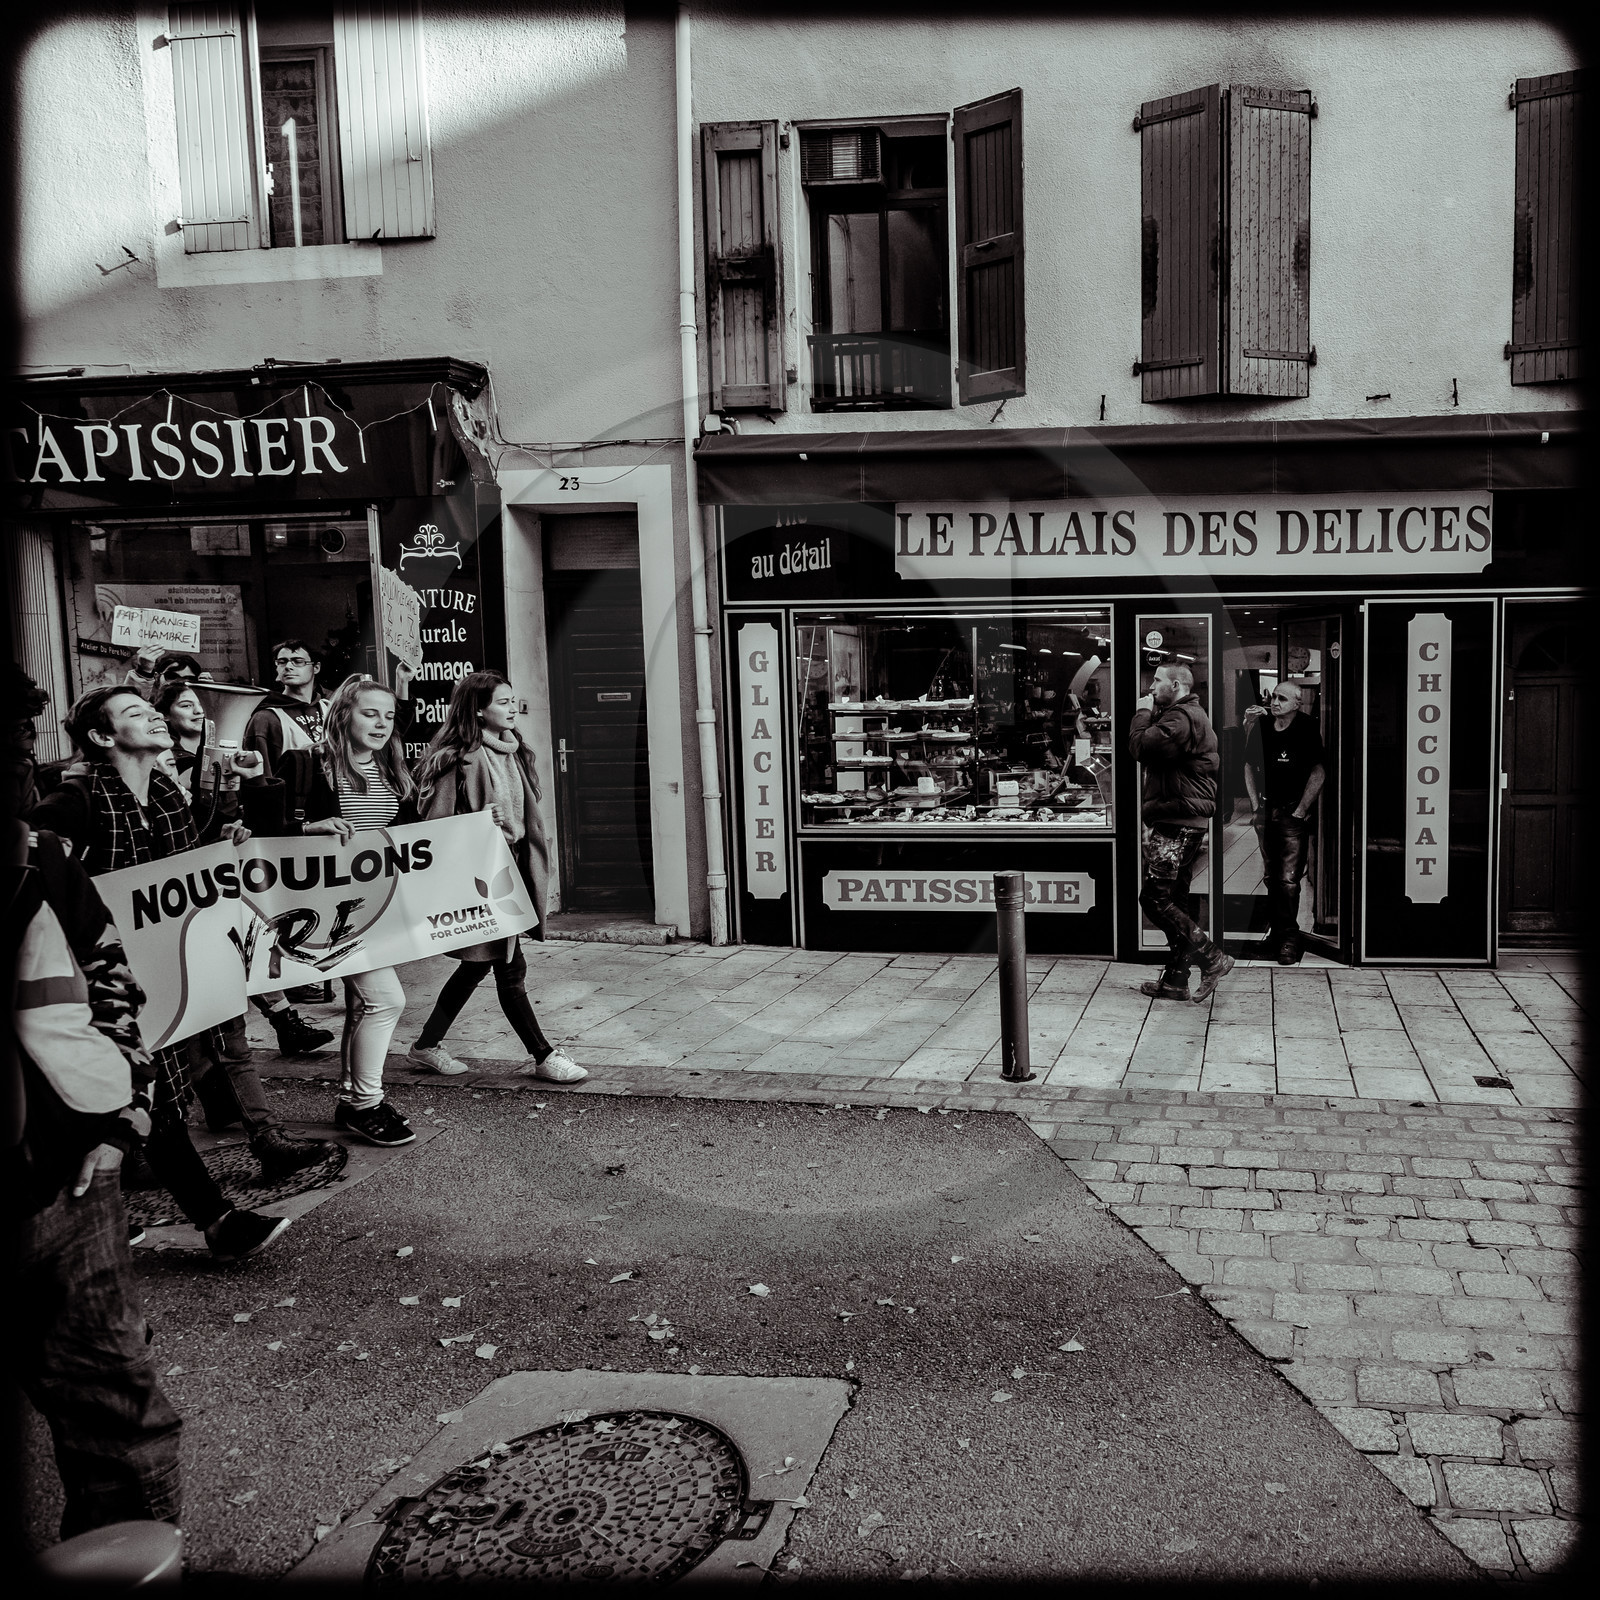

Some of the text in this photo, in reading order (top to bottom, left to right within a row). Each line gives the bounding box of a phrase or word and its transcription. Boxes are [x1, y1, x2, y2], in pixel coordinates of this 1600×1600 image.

[4, 415, 349, 485] TAPISSIER
[559, 477, 580, 492] 23
[896, 504, 1492, 557] LE PALAIS DES DELICES
[751, 537, 832, 579] au détail
[415, 588, 476, 614] NTURE
[117, 625, 131, 637] TA
[151, 614, 198, 630] RANGES
[416, 660, 474, 684] annage
[405, 742, 430, 759] PEI
[748, 649, 777, 873] GLACIER
[1414, 641, 1442, 876] CHOCOLAT
[132, 839, 434, 930] NOUS OULONS
[427, 903, 493, 929] YOUTH
[430, 918, 498, 941] FOR CLIMATE
[482, 927, 500, 937] GAP
